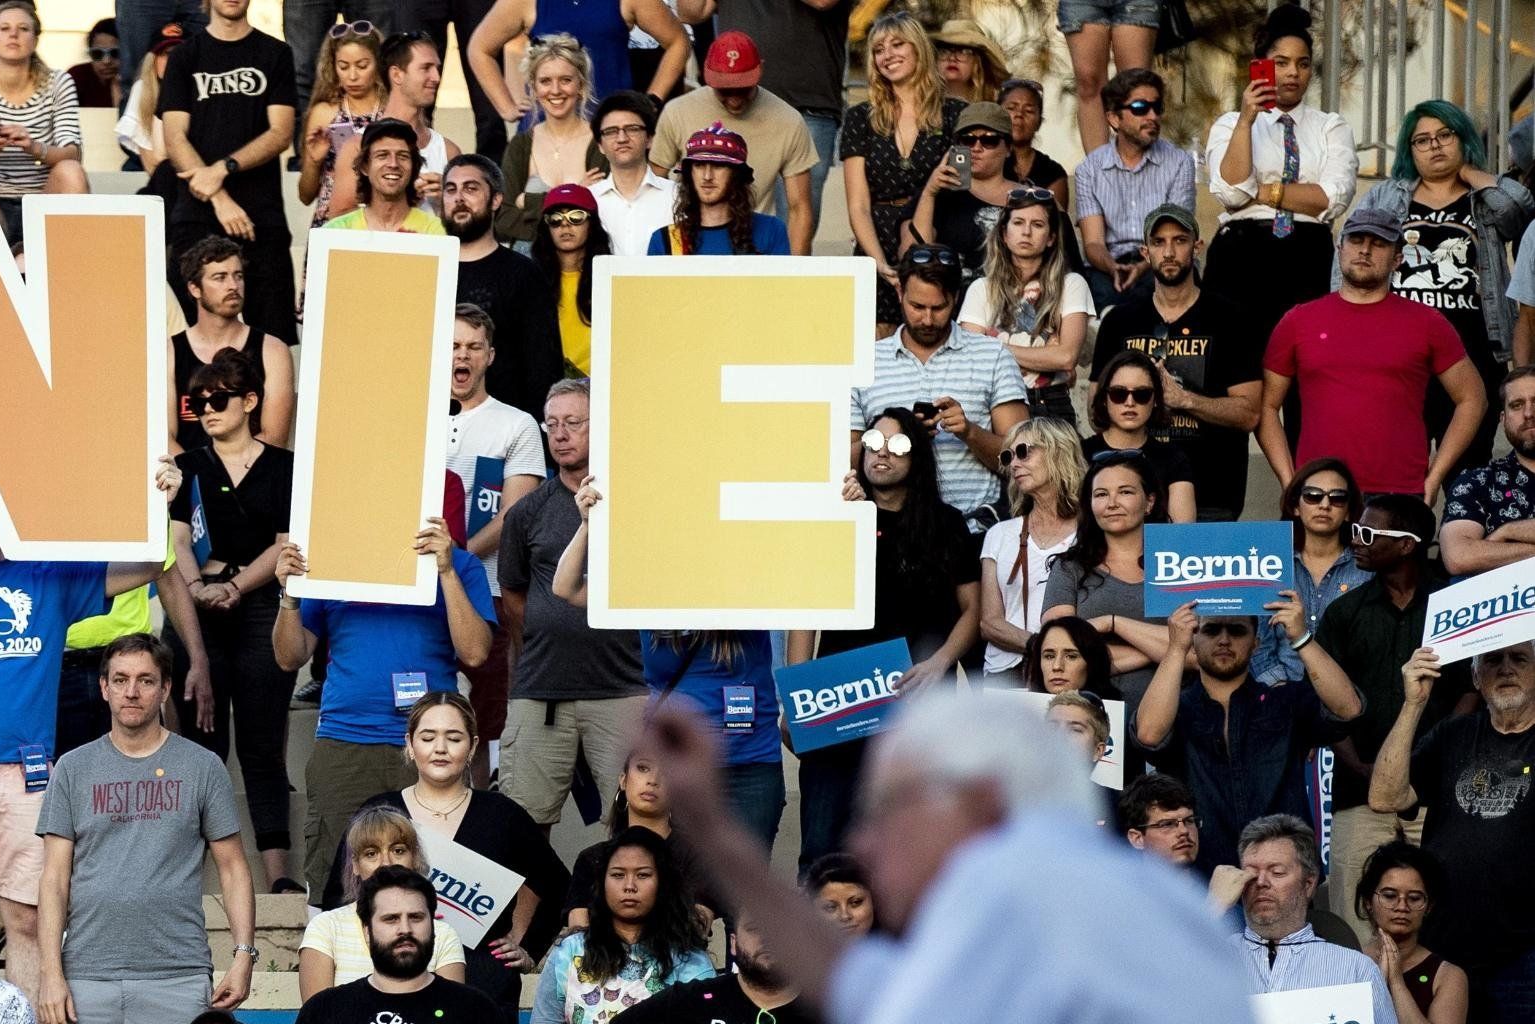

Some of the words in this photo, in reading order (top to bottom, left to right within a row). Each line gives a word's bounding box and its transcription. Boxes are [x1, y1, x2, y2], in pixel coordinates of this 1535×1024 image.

[192, 67, 267, 101] VANS
[1126, 338, 1146, 352] TIM
[1148, 339, 1208, 356] BCKLEY
[1153, 546, 1284, 583] Bernie
[1430, 584, 1535, 638] Bernie
[5, 637, 42, 654] 2020
[726, 705, 754, 715] Bernie
[789, 667, 905, 720] Bernie
[92, 781, 132, 815] WEST
[135, 779, 183, 812] COAST
[110, 813, 162, 823] CALIFORNIA
[428, 867, 495, 917] rnie
